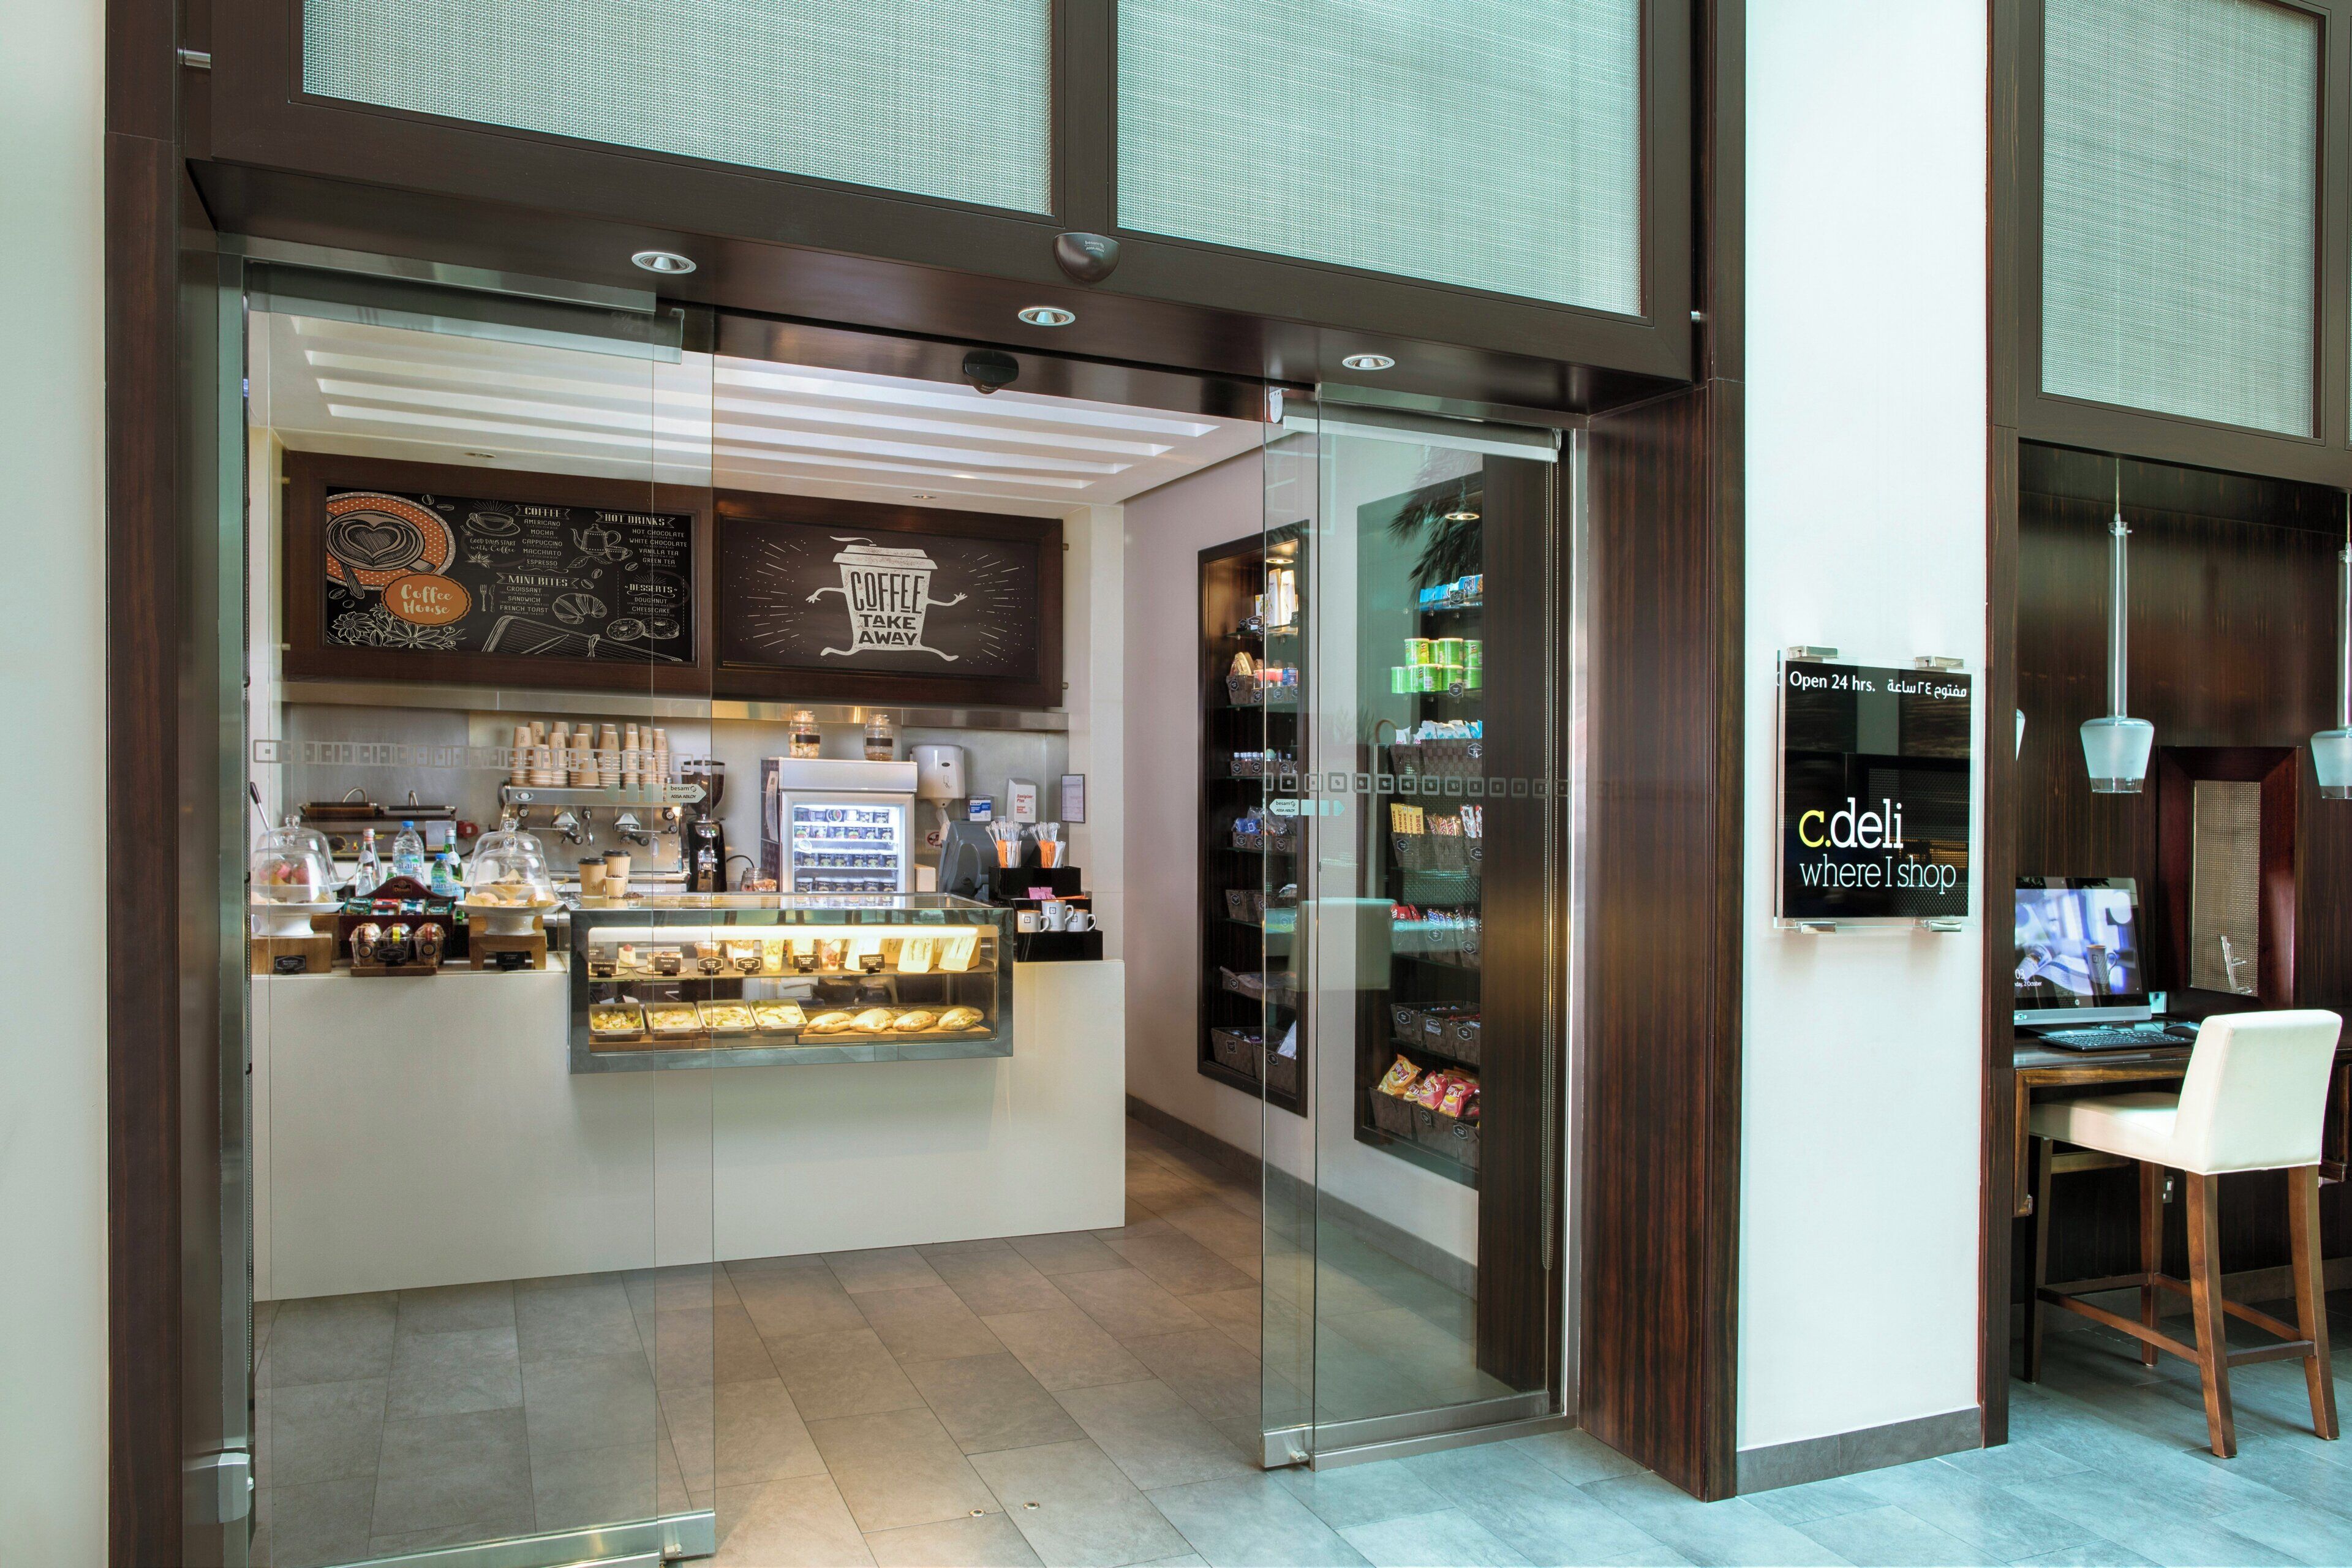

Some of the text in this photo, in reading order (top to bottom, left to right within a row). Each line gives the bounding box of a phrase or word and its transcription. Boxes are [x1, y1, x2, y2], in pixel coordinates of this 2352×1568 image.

[525, 507, 560, 518] COFFEE
[605, 514, 665, 526] HOT DRINKS
[491, 545, 515, 554] Coffee
[508, 575, 568, 586] MINI BITES
[401, 584, 453, 603] Coffee
[630, 584, 673, 593] DESSERTS
[851, 571, 924, 614] COFFEE
[403, 601, 450, 614] House
[859, 614, 916, 630] TAKE
[859, 631, 918, 645] AWAY
[1790, 671, 1875, 692] Open 24 hrs.
[1934, 684, 1967, 699] مفتوح
[1799, 797, 1904, 849] c.deli
[1800, 854, 1956, 895] where I shop
